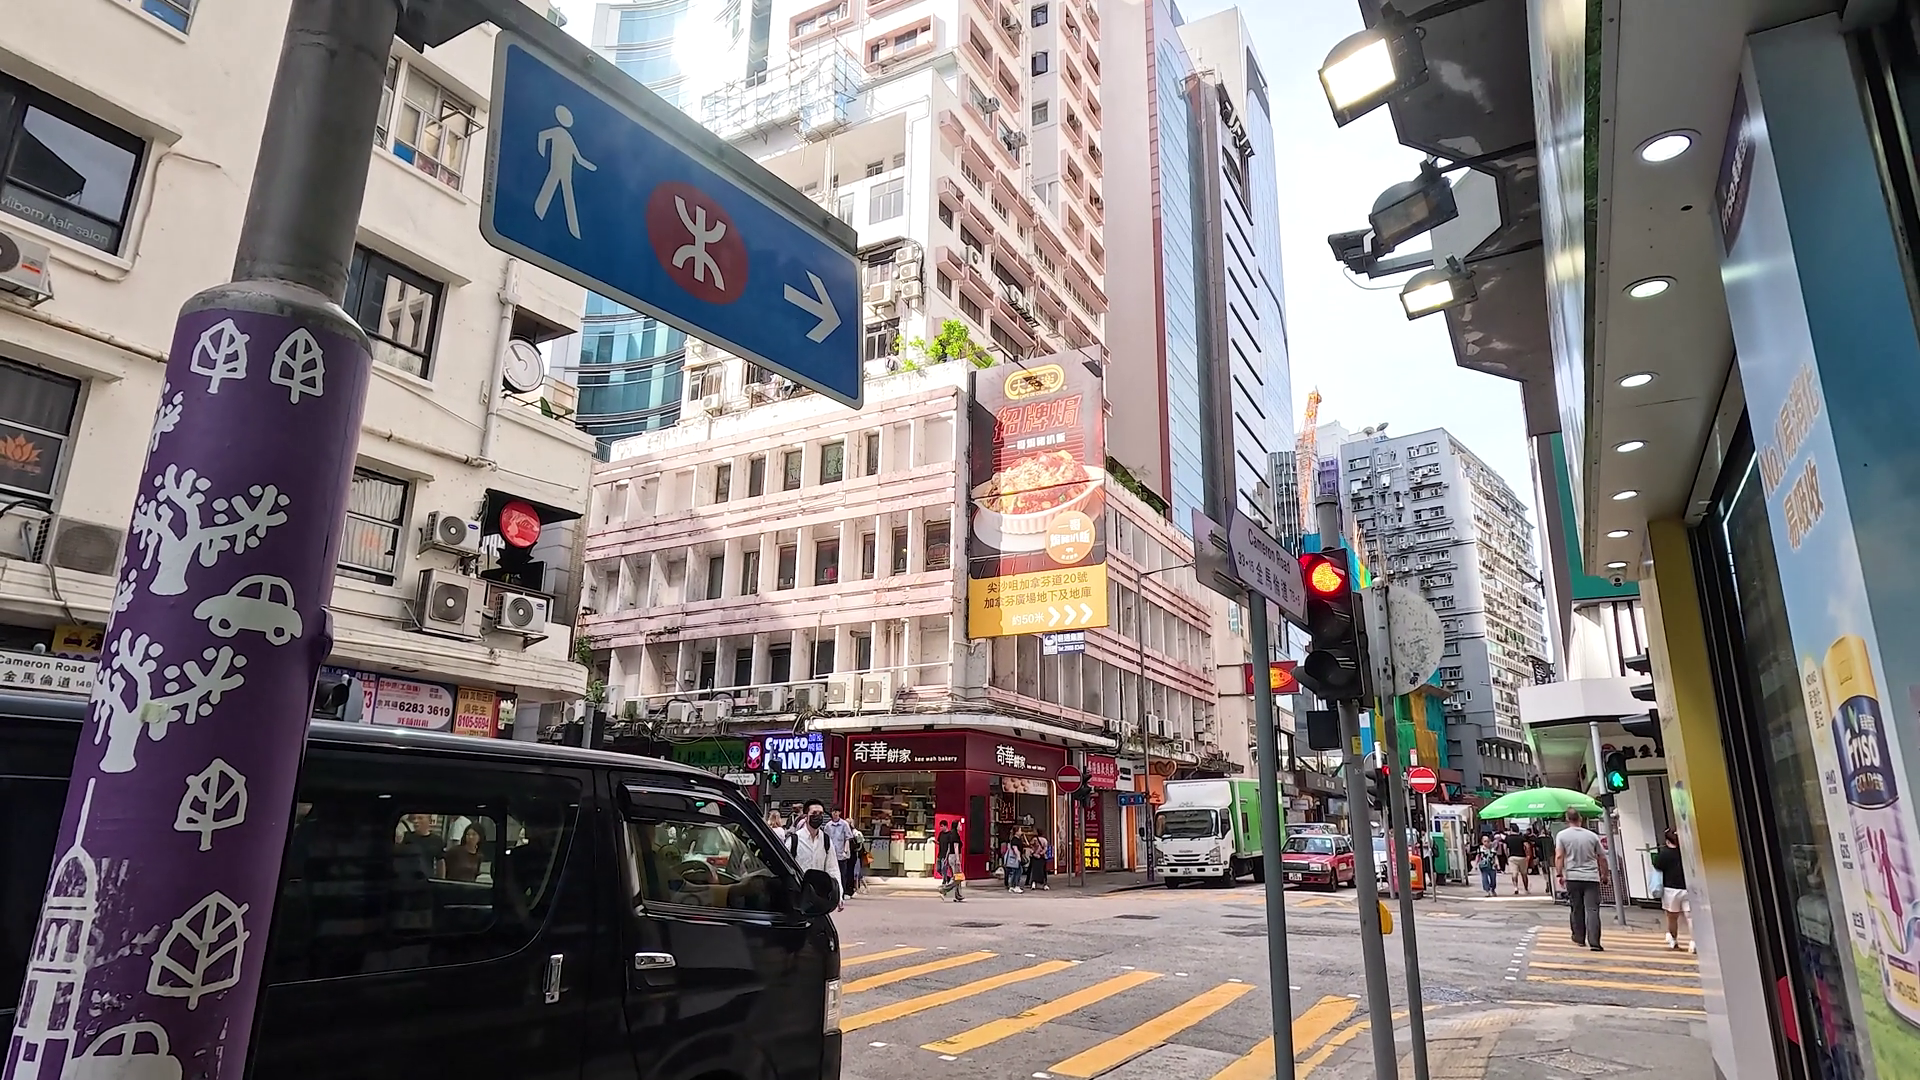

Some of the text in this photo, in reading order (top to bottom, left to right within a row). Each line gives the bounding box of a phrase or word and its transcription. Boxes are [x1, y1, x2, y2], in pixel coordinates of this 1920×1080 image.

[47, 212, 73, 230] hair
[75, 225, 110, 247] salon
[1247, 528, 1291, 575] Cameron Road
[987, 572, 1089, 594] 尖沙咀加拿芬道20號
[983, 586, 1092, 609] 加拿芬廣場地下及地庫
[1011, 613, 1044, 627] 約50米
[0, 654, 86, 674] Cameron Road
[3, 669, 71, 689] 金馬倫道
[398, 701, 425, 714] 6283
[427, 704, 451, 717] 3619
[765, 736, 809, 752] Crypto
[853, 740, 912, 764] 奇華餅家
[996, 744, 1026, 769] 奇華餅家
